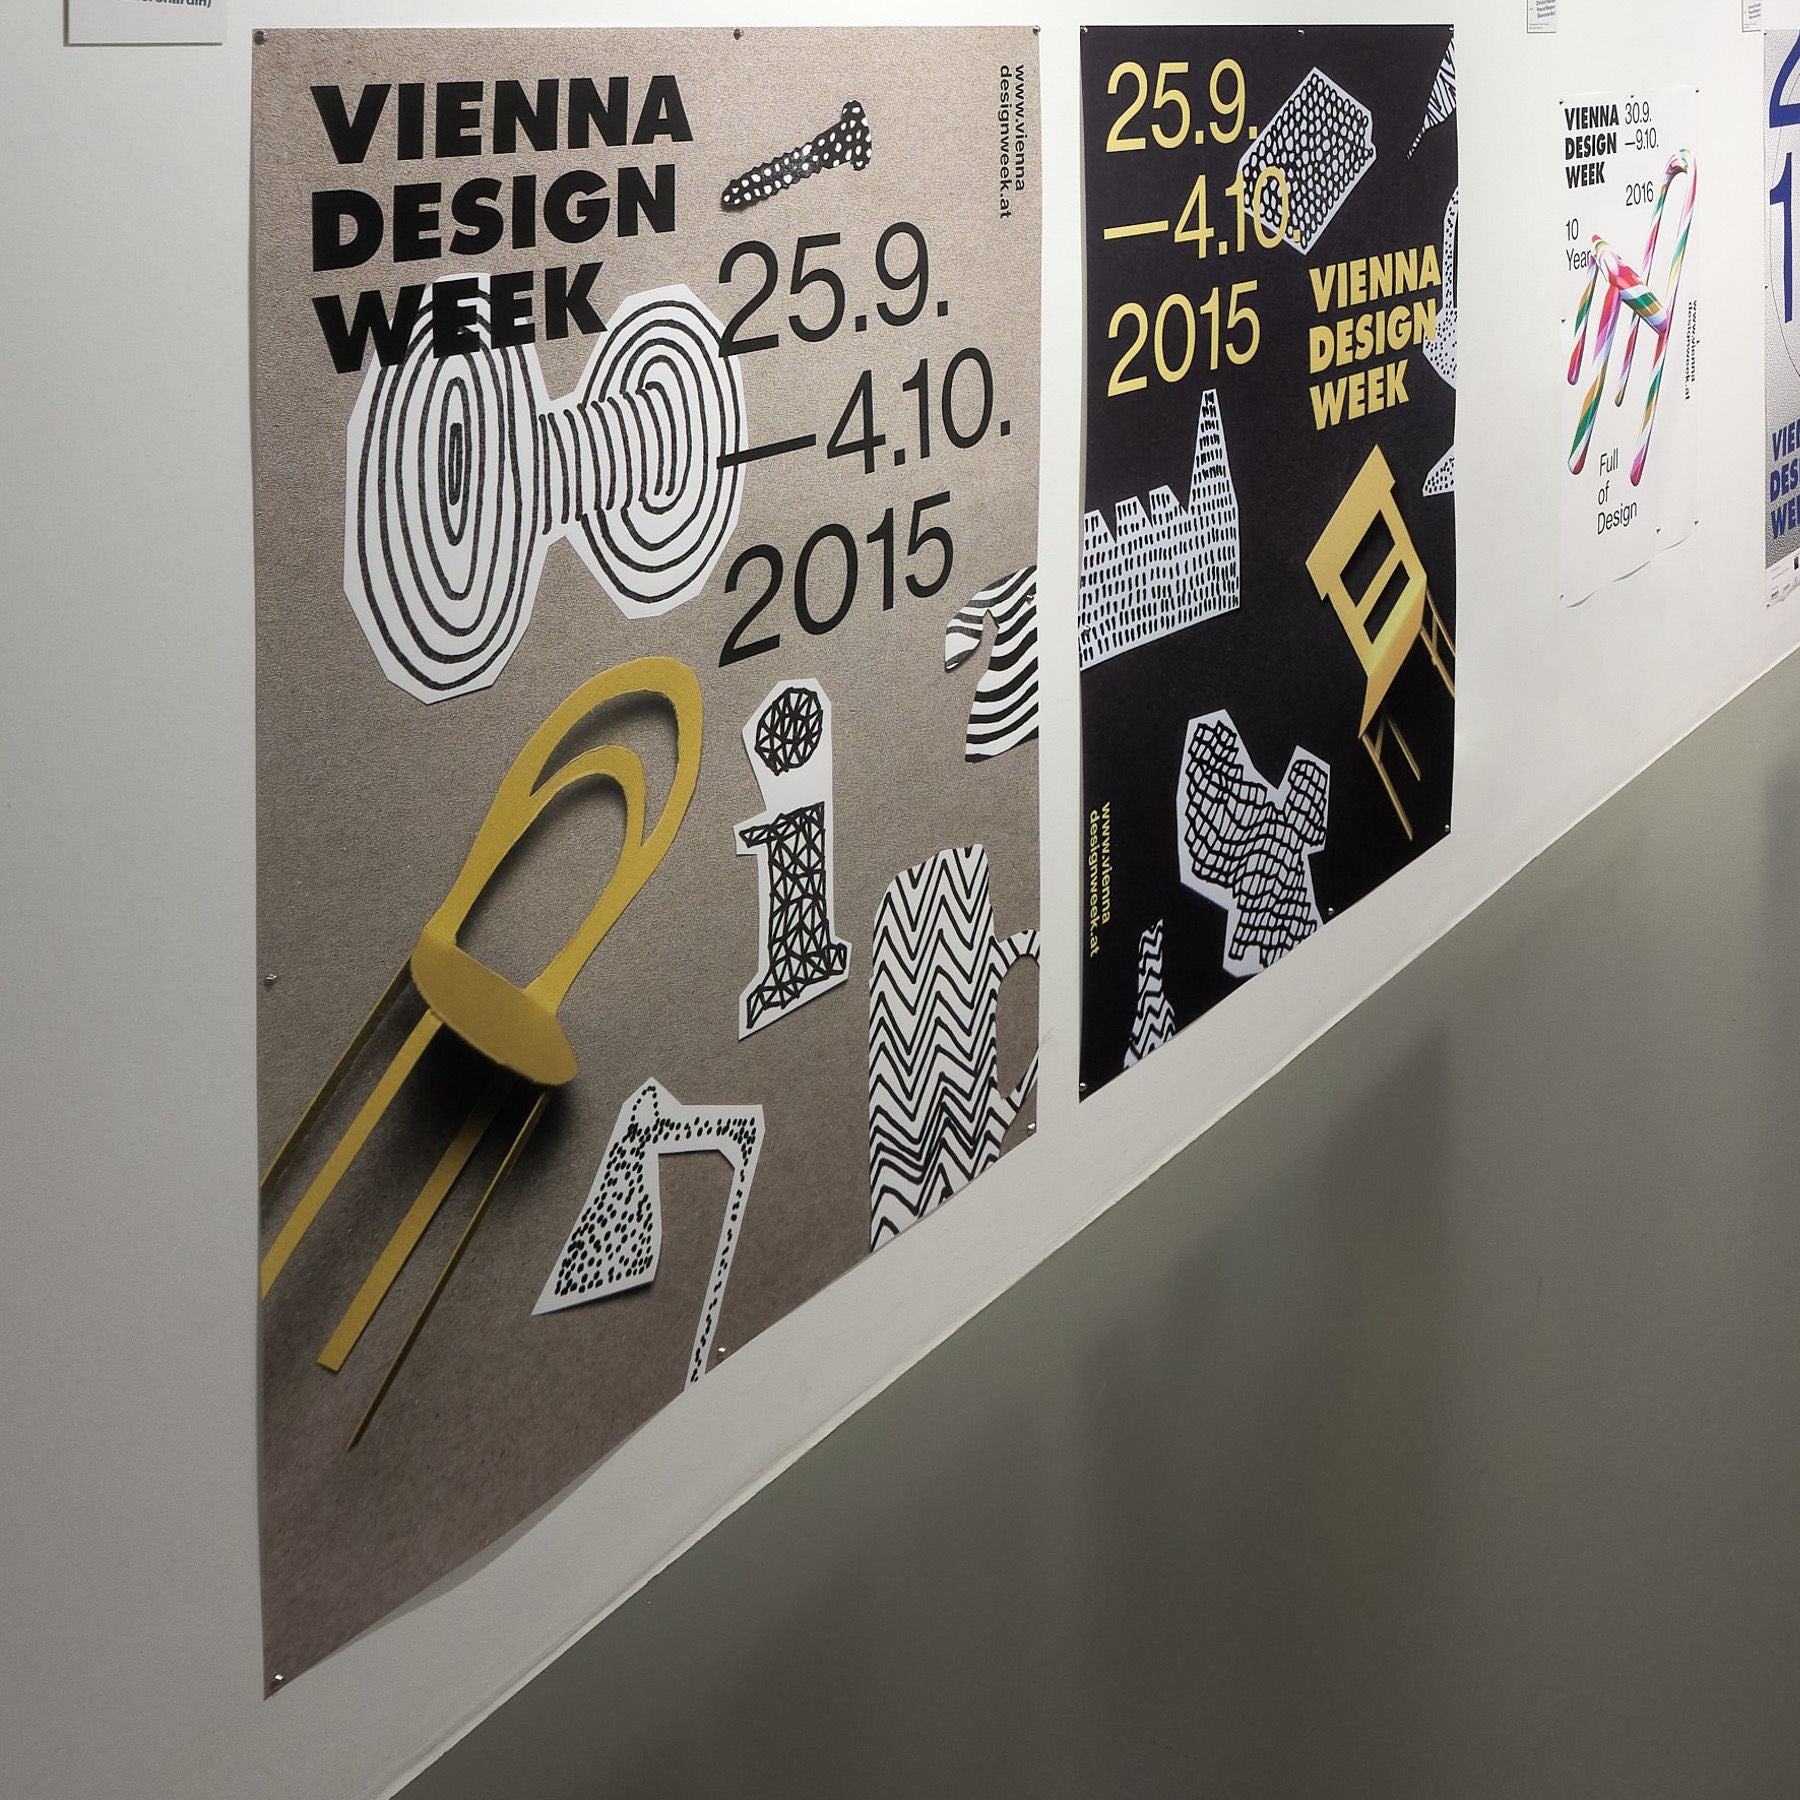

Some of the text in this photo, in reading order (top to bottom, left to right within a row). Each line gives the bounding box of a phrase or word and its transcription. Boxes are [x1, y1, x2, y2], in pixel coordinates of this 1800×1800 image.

[310, 75, 694, 164] VIENNA
[999, 64, 1012, 219] designweek.at
[1014, 64, 1026, 191] www.vienna
[1106, 58, 1258, 153] 25.9.
[1564, 101, 1652, 131] VIENNA 30.9.
[1565, 132, 1617, 160] DESIGN
[1565, 161, 1605, 189] WEEK
[1625, 181, 1654, 206] 2016
[311, 163, 676, 272] DESIGN
[1565, 218, 1579, 241] 10
[311, 261, 606, 375] WEEK
[718, 221, 950, 358] 25.9.
[1309, 244, 1442, 313] VIENNA
[1107, 279, 1261, 397] 2015
[1309, 298, 1437, 375] DESIGN
[1309, 358, 1409, 431] WEEK
[1597, 480, 1610, 505] of
[1599, 448, 1619, 476] Full
[1597, 501, 1637, 535] Design
[718, 491, 954, 669] 2015
[1089, 810, 1100, 957] designweek.at
[1100, 802, 1111, 925] www.vienna
